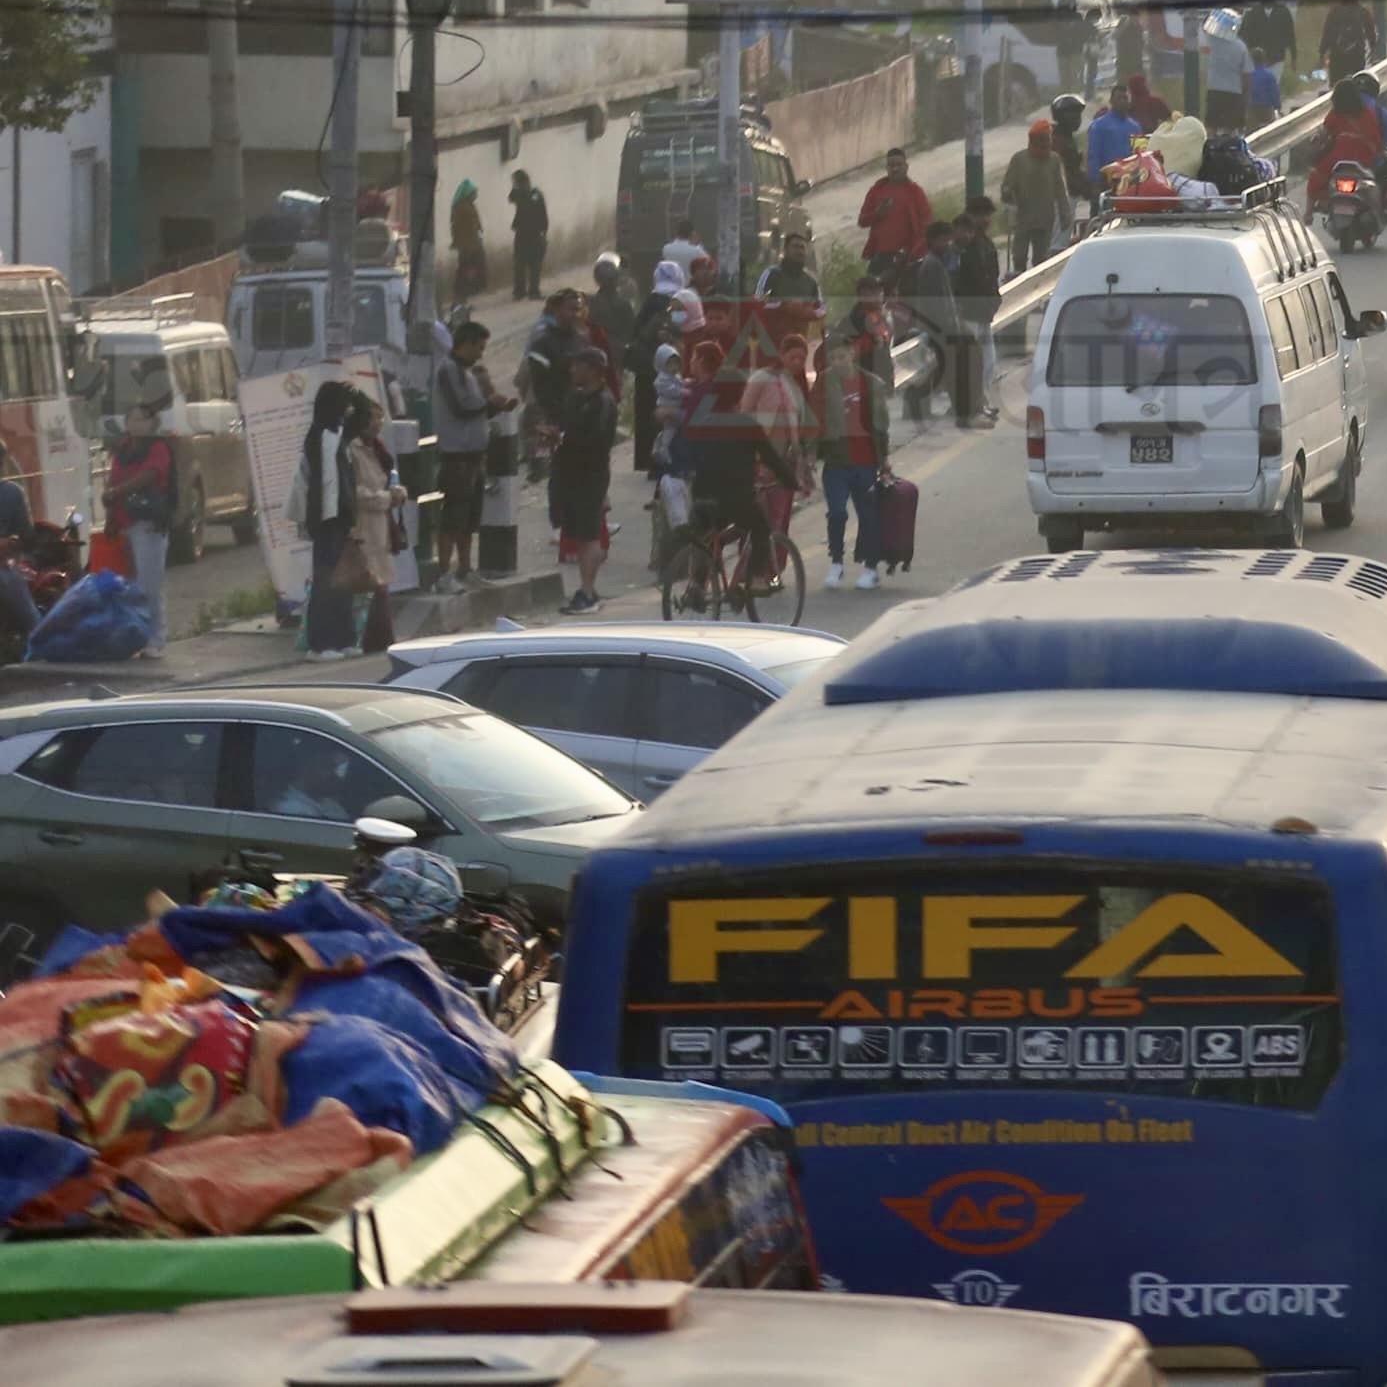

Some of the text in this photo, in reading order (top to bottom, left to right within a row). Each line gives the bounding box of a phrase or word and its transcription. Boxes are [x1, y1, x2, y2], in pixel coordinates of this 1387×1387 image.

[669, 894, 1303, 983] FIFA
[819, 988, 1147, 1018] AIRBUS
[1255, 1035, 1298, 1056] ABS
[822, 1122, 899, 1147] Central
[905, 1121, 957, 1146] Duct
[961, 1120, 991, 1145] Air
[995, 1120, 1101, 1144] Condition
[1138, 1119, 1194, 1143] Fleet
[939, 1197, 1023, 1231] AC
[1128, 1271, 1351, 1318] बिराटनगर
